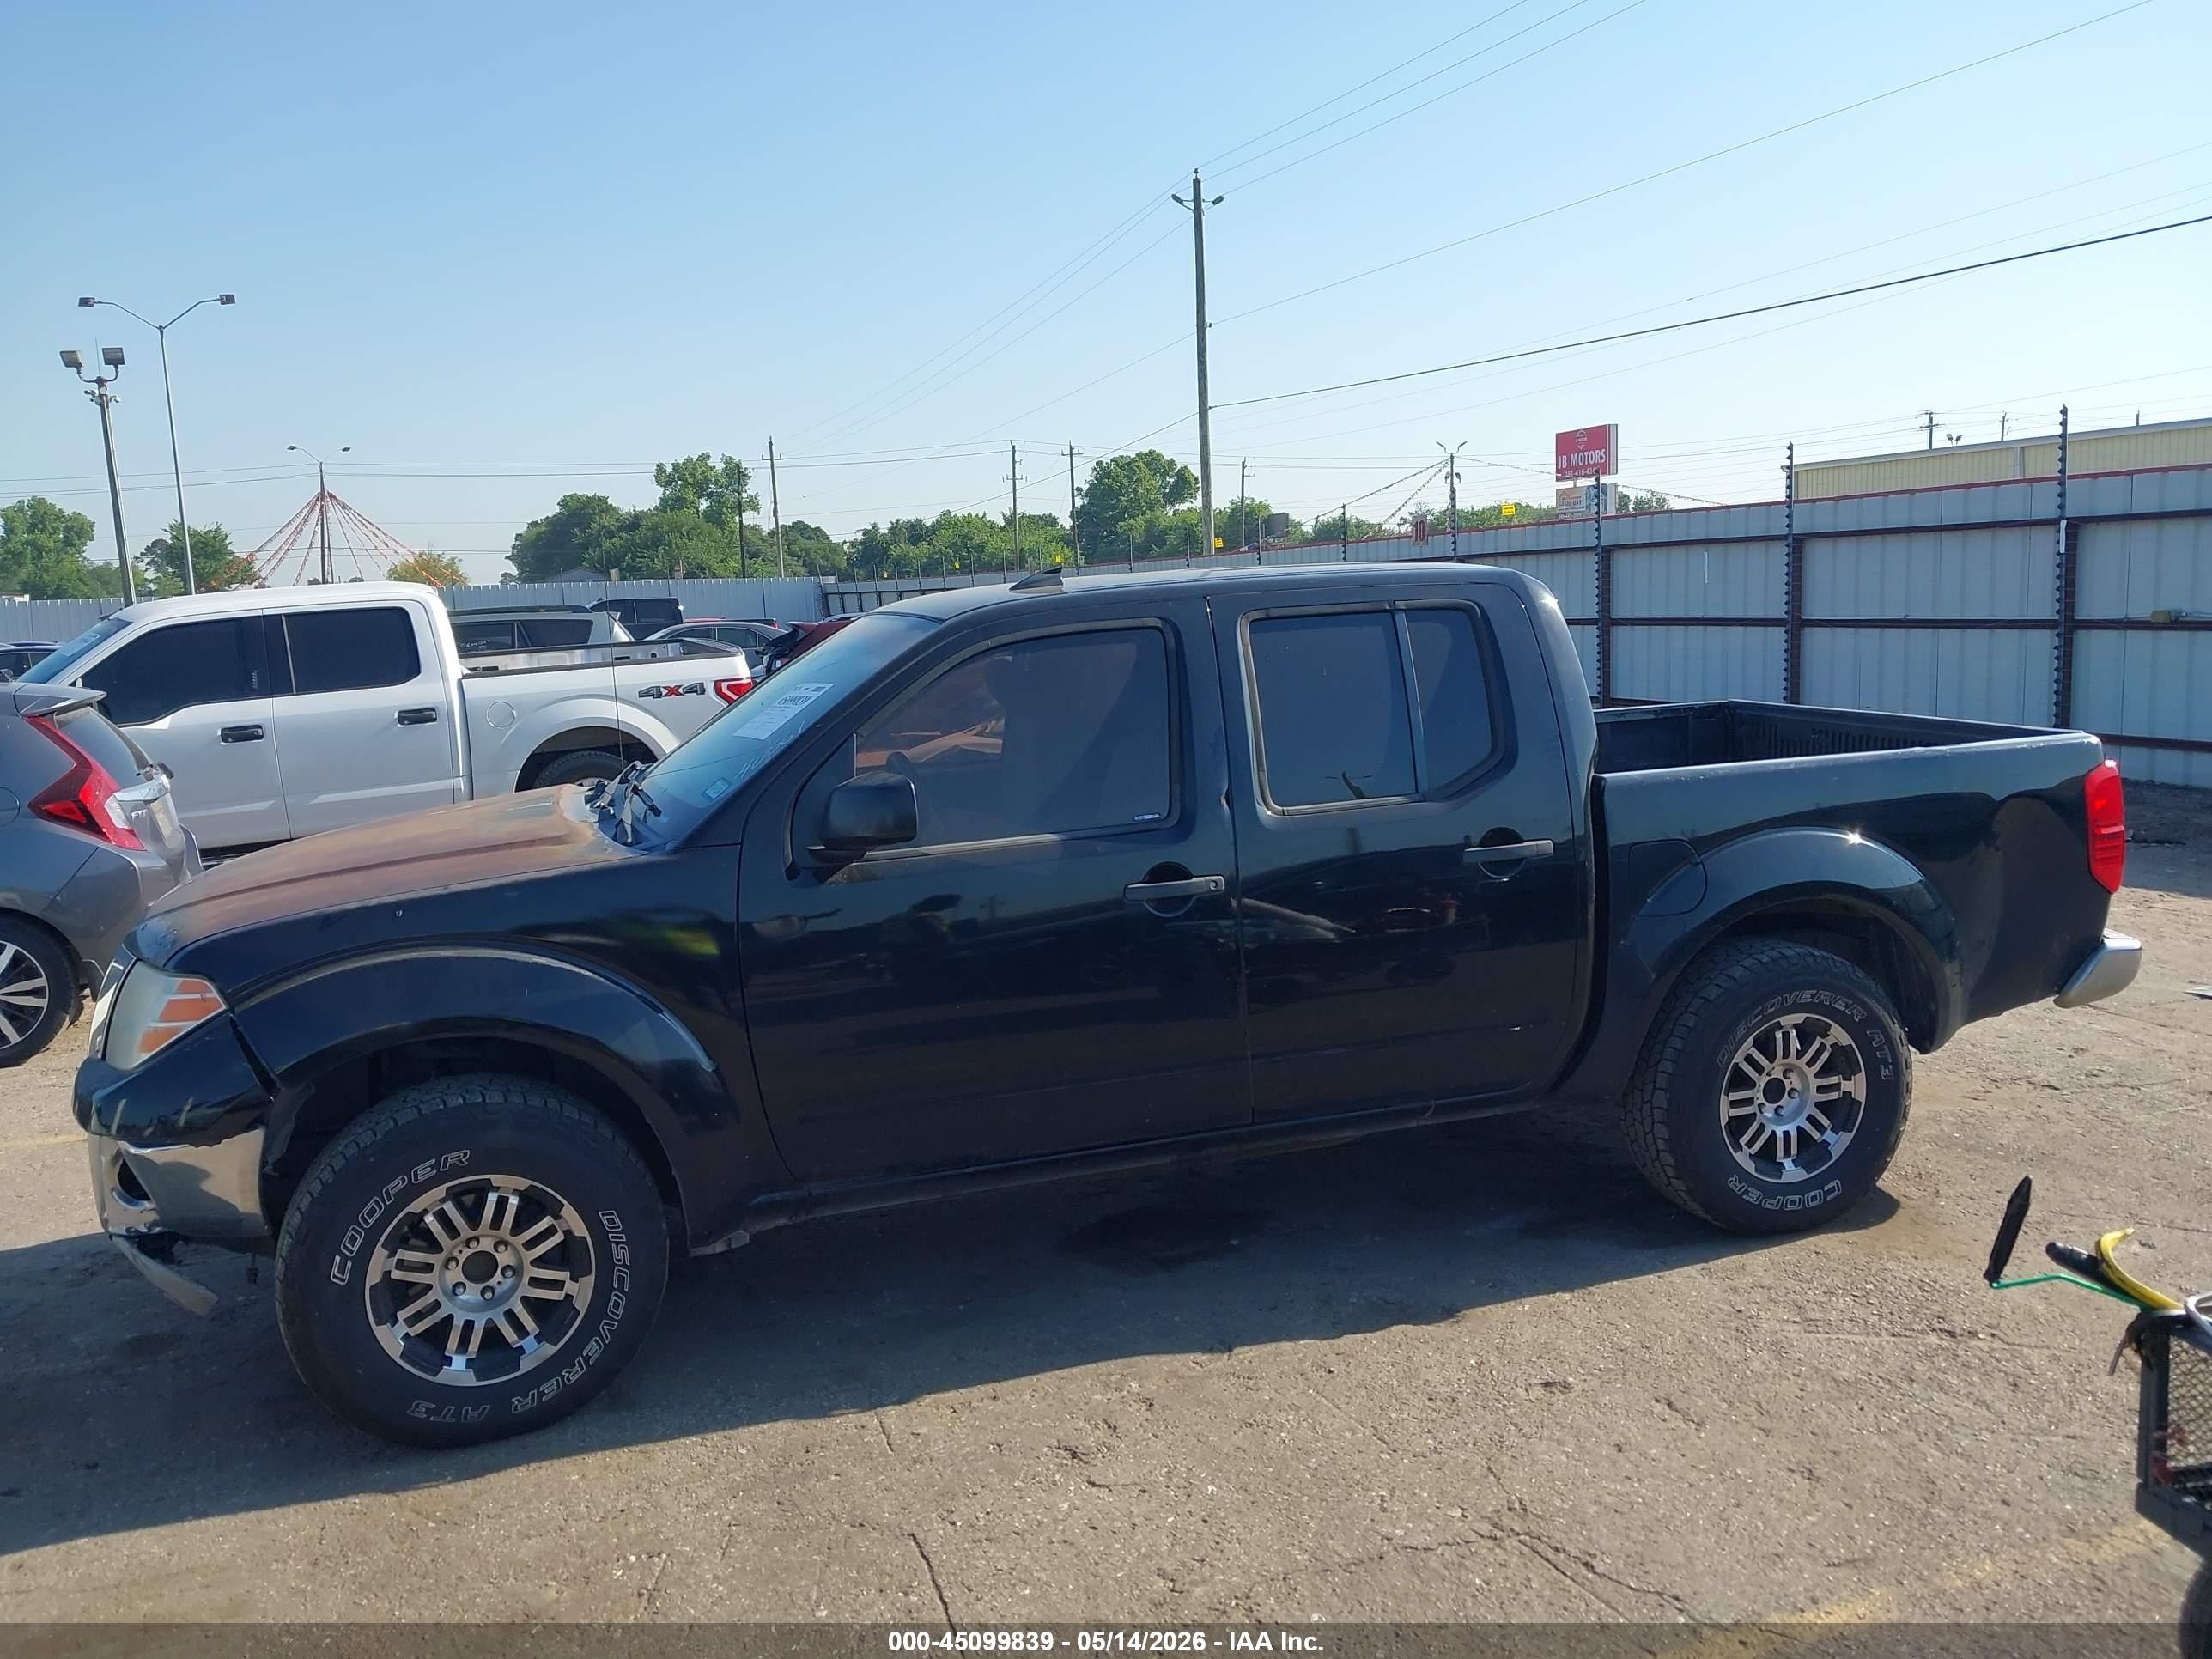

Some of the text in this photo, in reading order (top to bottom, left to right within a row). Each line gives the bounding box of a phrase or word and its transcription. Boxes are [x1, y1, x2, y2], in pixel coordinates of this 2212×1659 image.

[1558, 448, 1606, 469] JB MOTORS
[131, 809, 147, 823] FIT
[1718, 989, 1895, 1081] DISCOVERER AT3
[330, 1149, 471, 1285] COOPER
[1727, 1174, 1842, 1211] COOPER
[406, 1210, 630, 1423] DISCOVERER AT3
